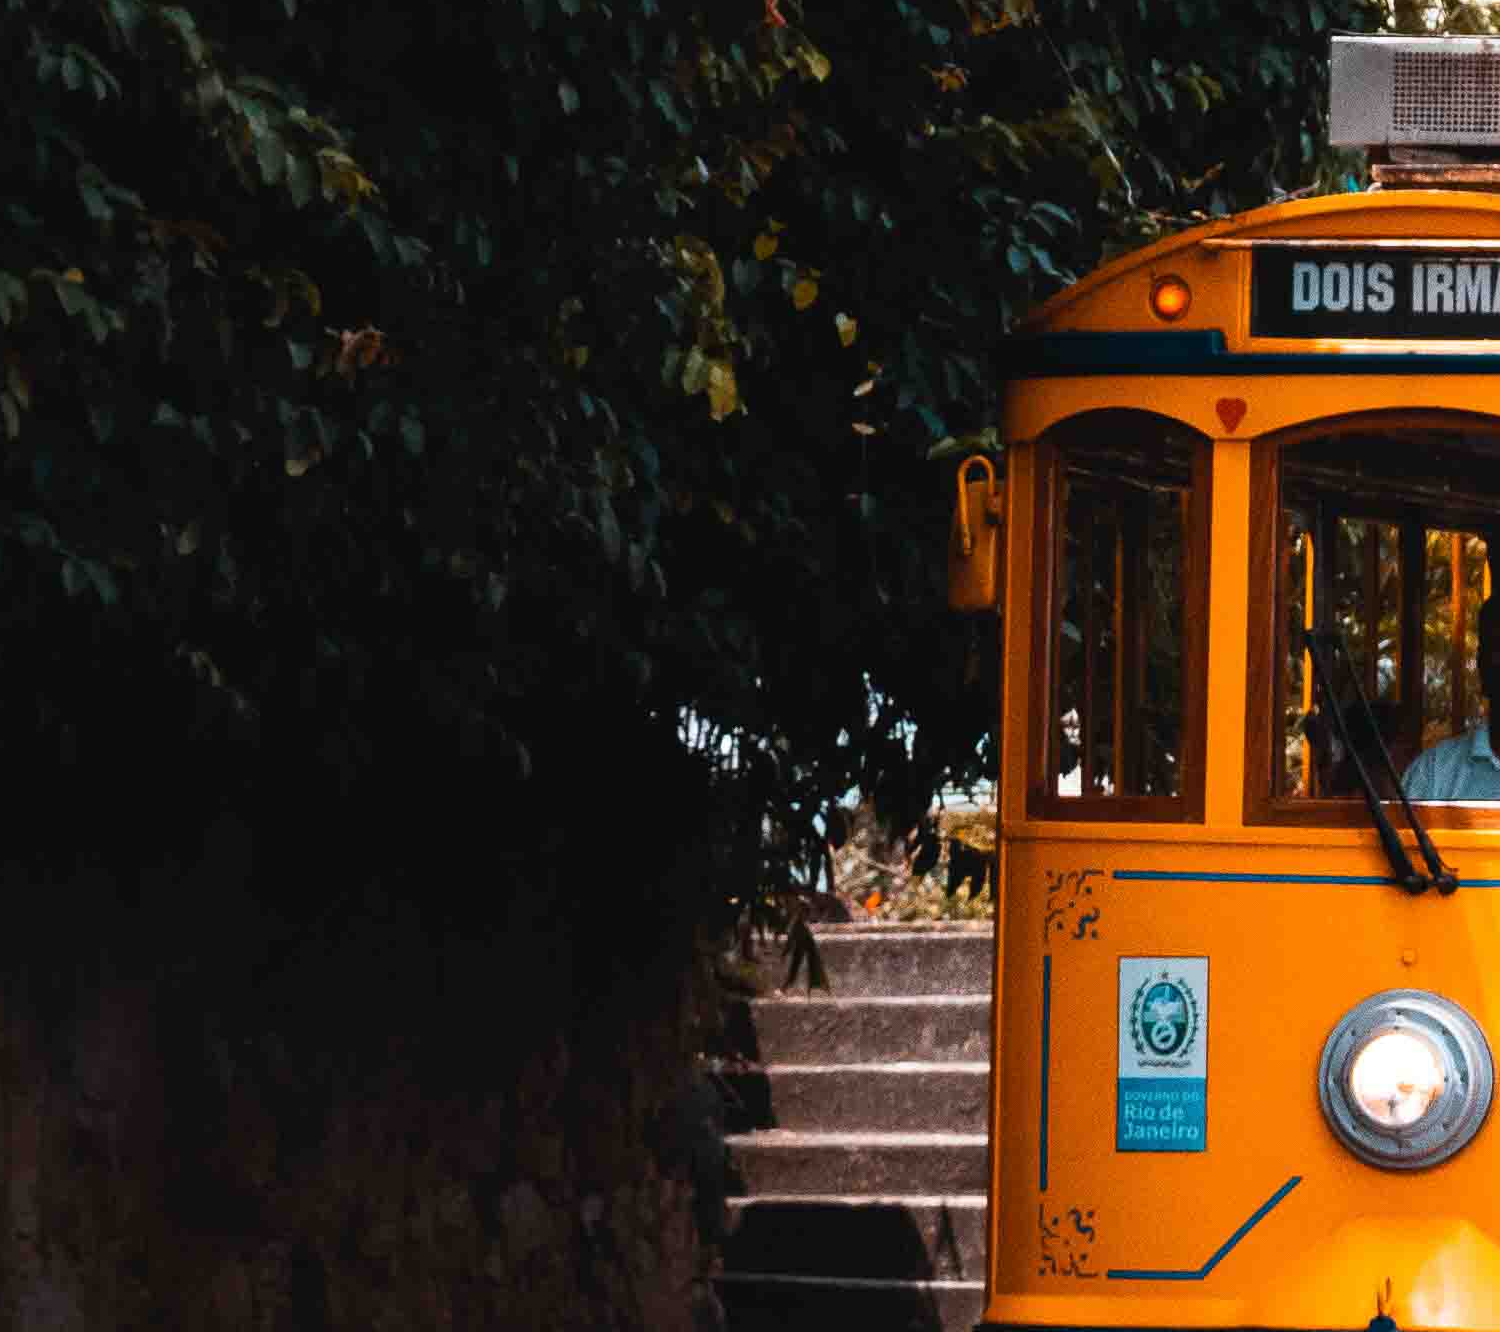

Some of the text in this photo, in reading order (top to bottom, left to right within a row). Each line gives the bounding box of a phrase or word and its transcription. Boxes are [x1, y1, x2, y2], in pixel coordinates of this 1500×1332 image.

[1292, 262, 1396, 313] DOIS
[1123, 1100, 1187, 1121] Rio de
[1123, 1122, 1200, 1141] Janeiro
